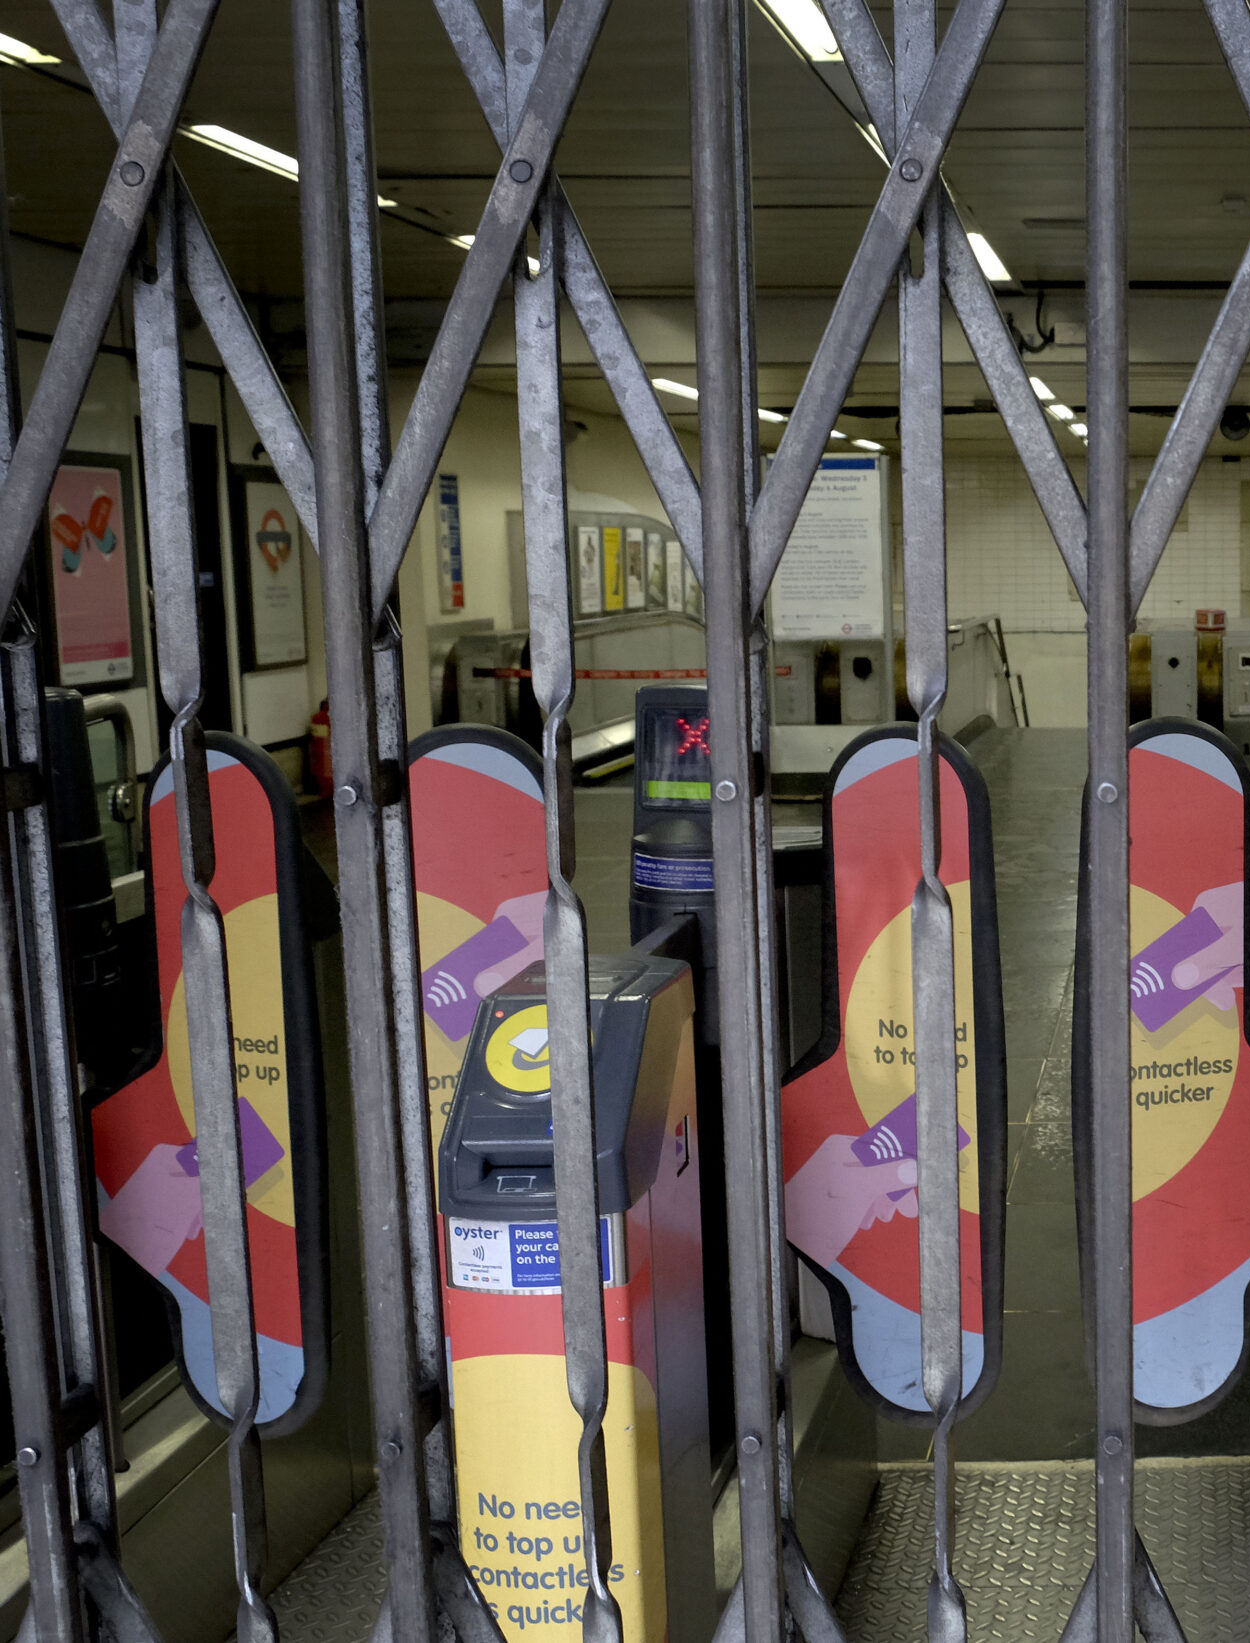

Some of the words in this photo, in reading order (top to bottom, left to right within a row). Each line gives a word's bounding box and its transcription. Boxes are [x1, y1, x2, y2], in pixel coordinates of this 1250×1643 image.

[878, 1018, 908, 1039] No
[874, 1045, 895, 1064] to
[900, 1047, 916, 1066] to
[255, 1065, 280, 1086] up
[1135, 1082, 1214, 1111] quicker
[454, 1226, 500, 1241] oyster
[515, 1229, 554, 1240] Please
[515, 1243, 542, 1254] your
[545, 1243, 559, 1251] ca
[516, 1256, 532, 1264] on
[535, 1254, 556, 1264] the
[478, 1492, 516, 1519] No
[525, 1501, 581, 1520] nee
[473, 1526, 499, 1552] to
[506, 1531, 554, 1562] top
[507, 1598, 583, 1630] quick
